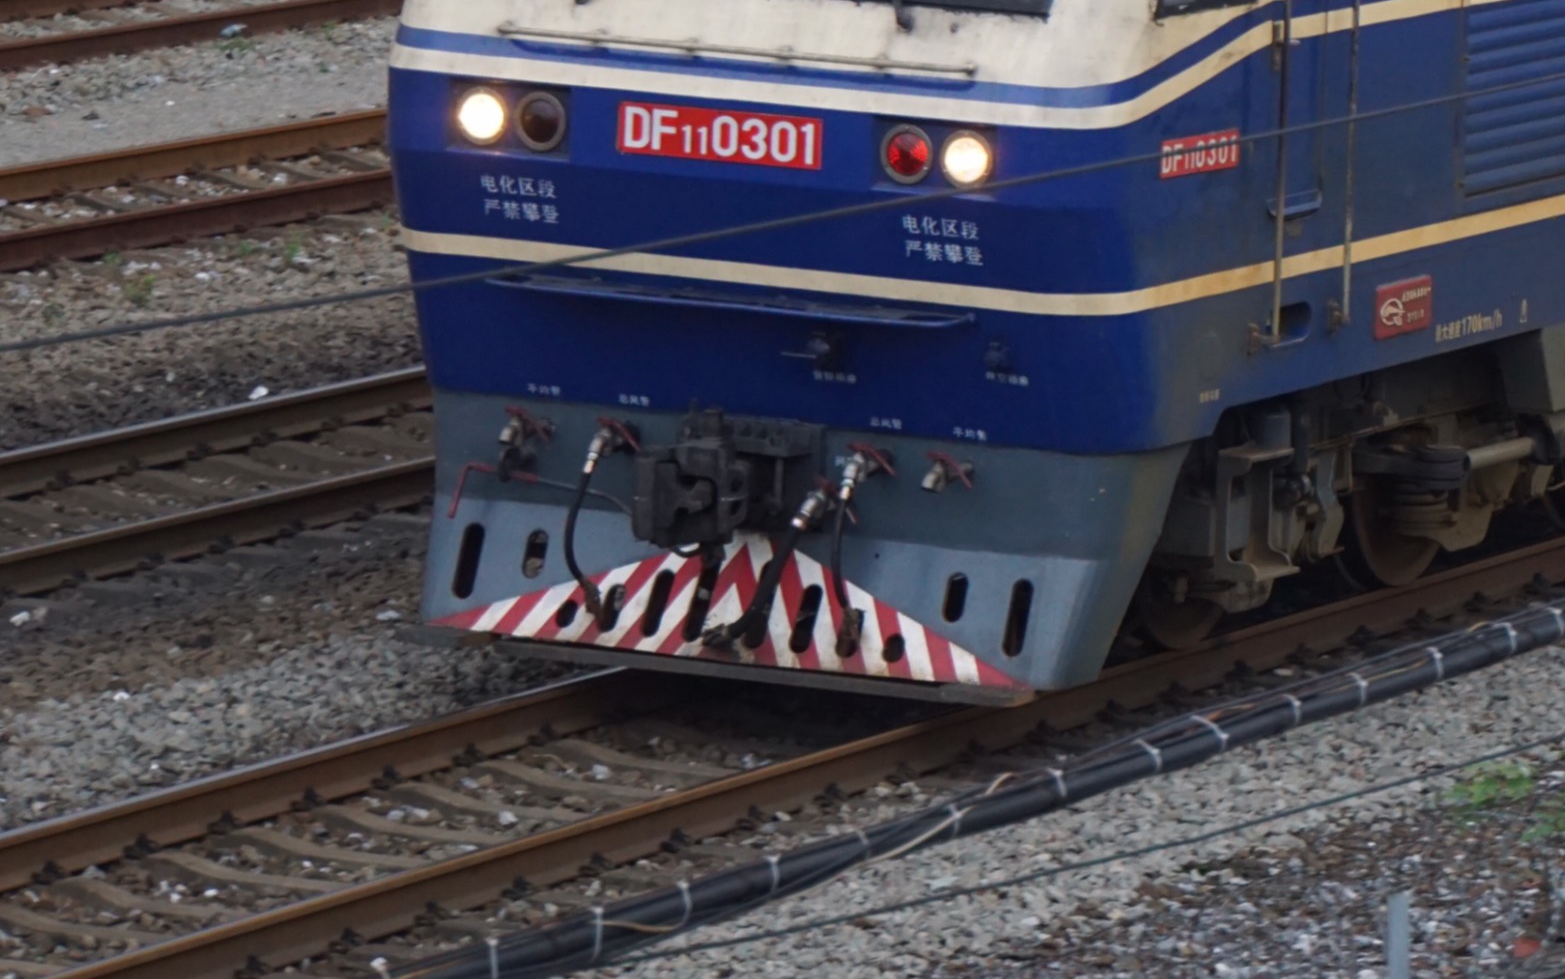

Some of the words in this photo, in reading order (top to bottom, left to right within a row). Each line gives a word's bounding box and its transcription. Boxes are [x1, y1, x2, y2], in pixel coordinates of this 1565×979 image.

[623, 105, 815, 166] DF110301
[1162, 135, 1238, 174] DF110301
[480, 174, 557, 199] 电化区段
[483, 198, 560, 224] 严禁攀登
[902, 214, 979, 240] 电化区段
[905, 240, 983, 266] 严禁攀登
